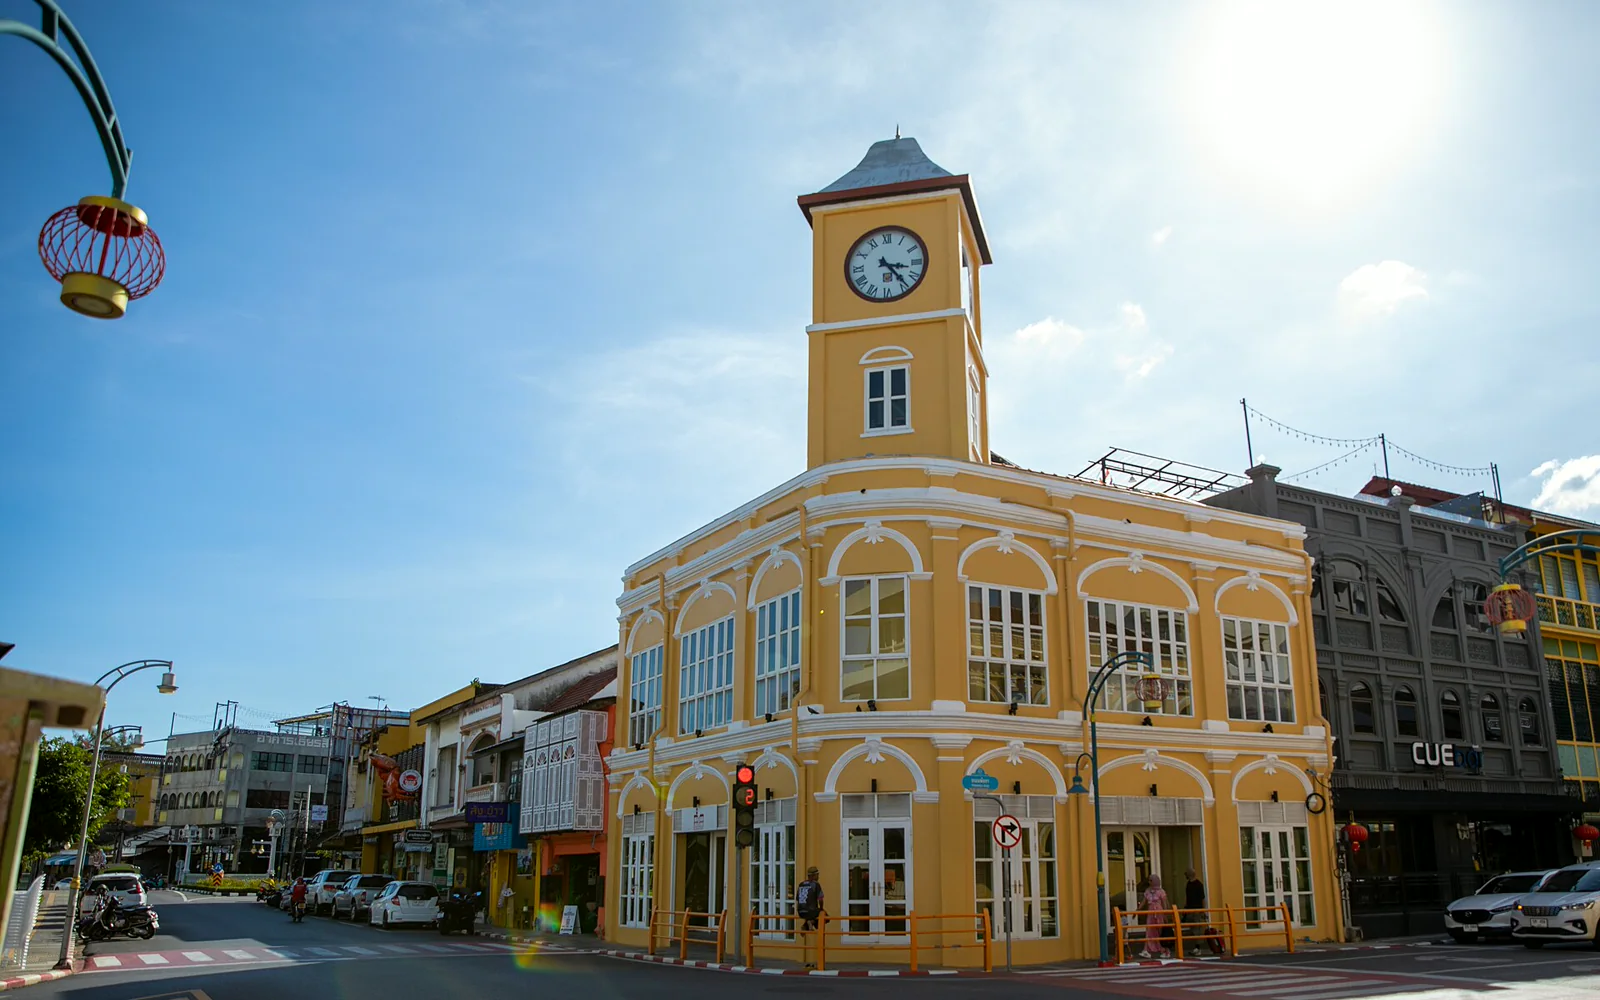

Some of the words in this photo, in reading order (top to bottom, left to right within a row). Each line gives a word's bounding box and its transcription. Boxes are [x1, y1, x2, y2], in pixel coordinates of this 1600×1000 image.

[867, 238, 878, 250] XI
[882, 234, 892, 244] XII
[898, 236, 905, 245] I
[907, 245, 918, 254] II
[856, 251, 868, 259] X
[908, 271, 920, 282] IV
[855, 275, 868, 289] VIII
[866, 284, 878, 297] VII
[883, 288, 893, 298] VI
[1412, 741, 1455, 767] CUE
